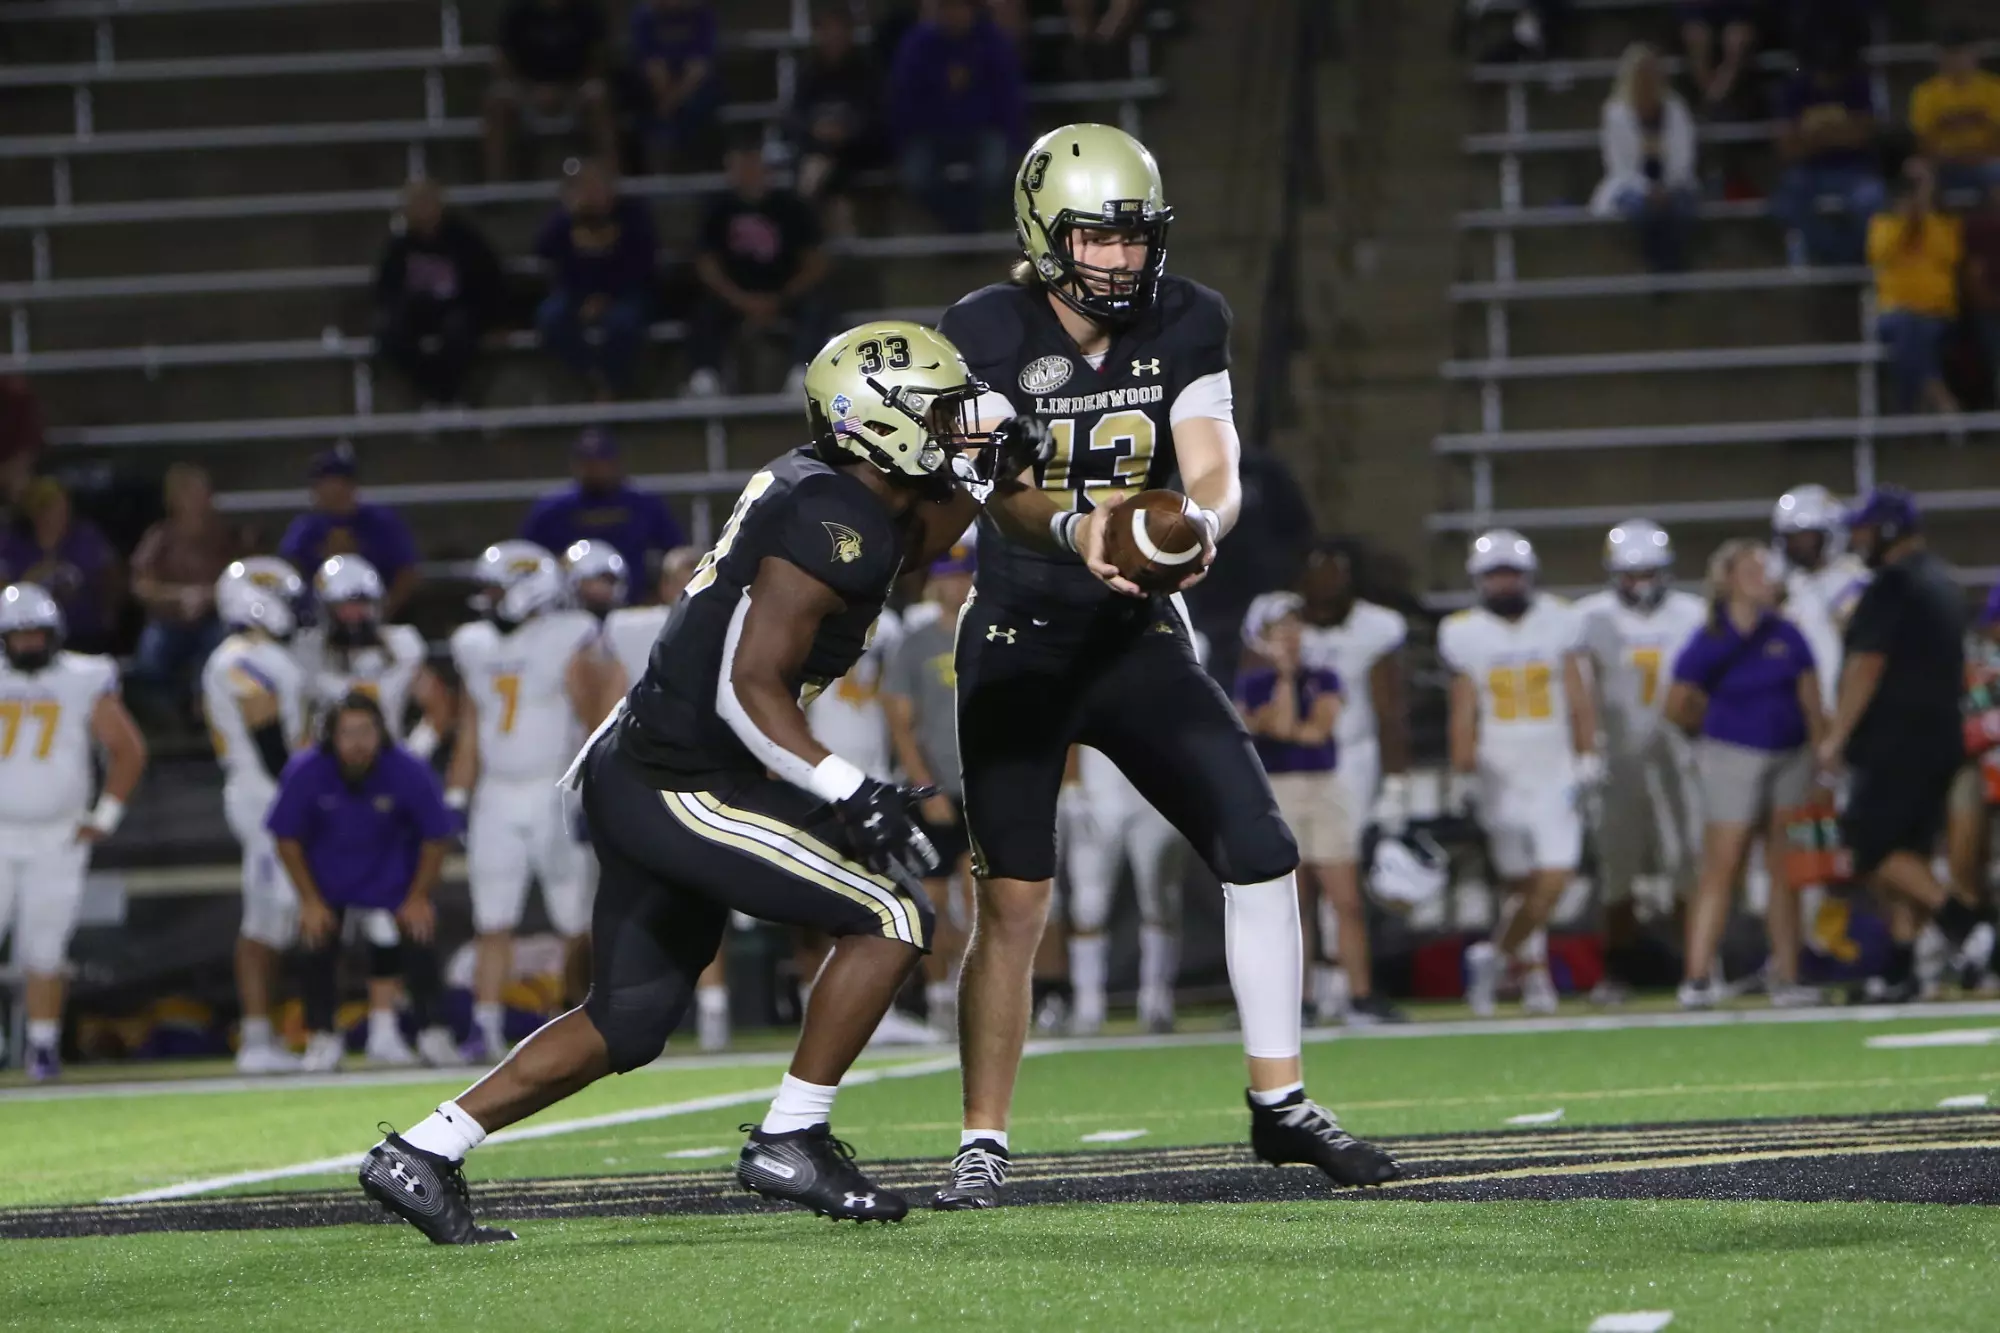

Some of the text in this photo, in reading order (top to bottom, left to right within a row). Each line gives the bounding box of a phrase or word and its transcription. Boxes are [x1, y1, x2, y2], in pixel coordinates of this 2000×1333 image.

[856, 335, 913, 378] 33
[1035, 384, 1164, 414] LINDENWOOD
[1039, 409, 1157, 513] 13
[0, 701, 61, 760] 77
